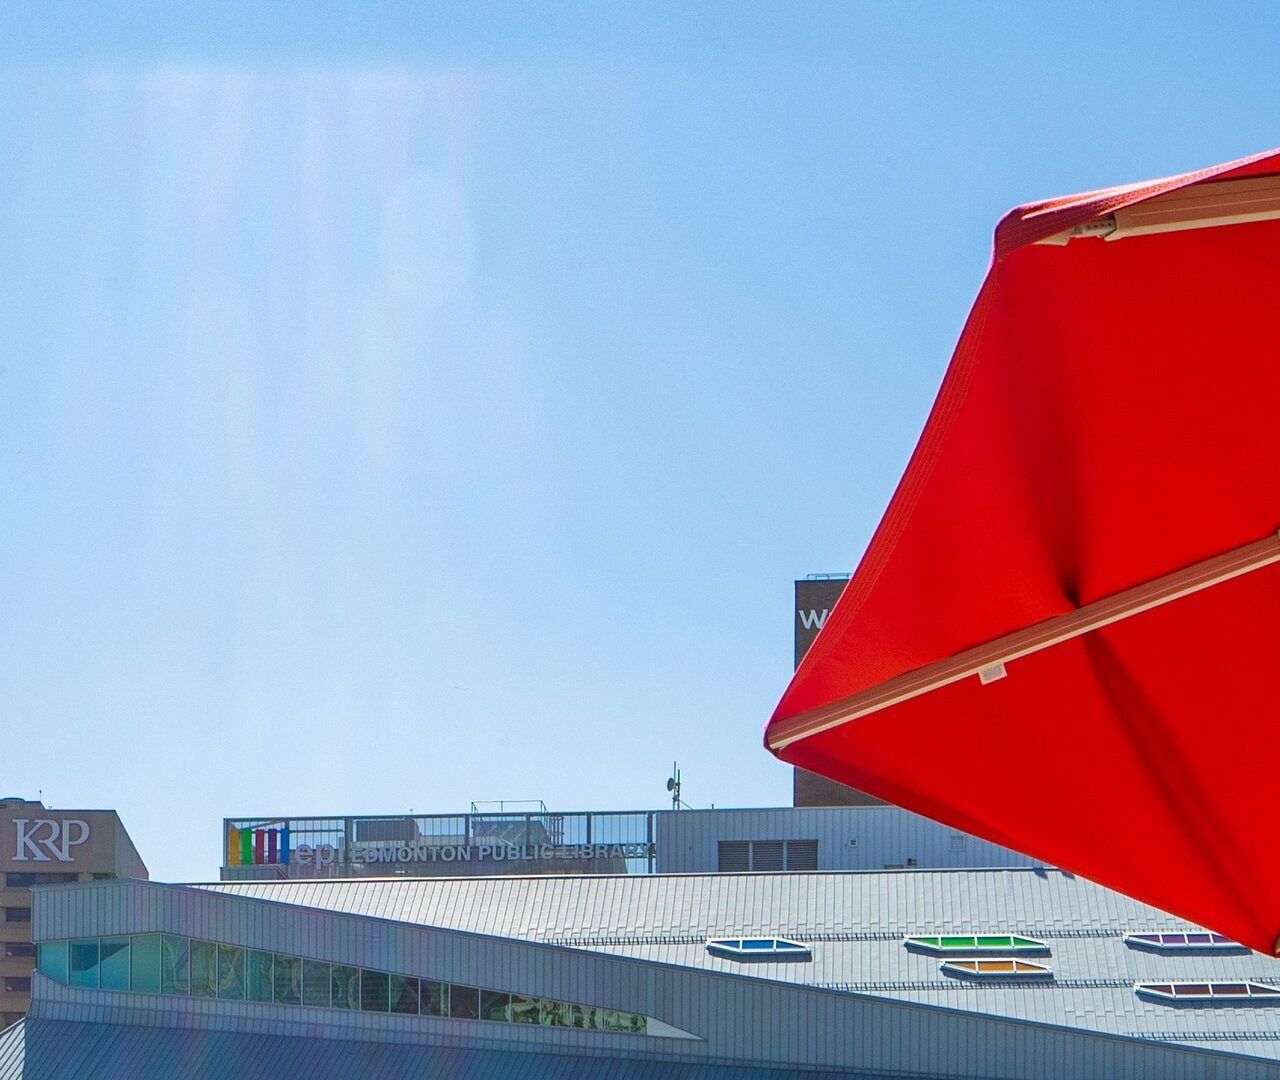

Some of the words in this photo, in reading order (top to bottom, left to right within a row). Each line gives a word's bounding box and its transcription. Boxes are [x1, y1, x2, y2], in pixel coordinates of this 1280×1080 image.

[12, 818, 90, 862] KRP
[350, 845, 471, 863] EDMONTON
[477, 844, 555, 861] PUBLIC
[561, 842, 653, 860] LIBRARY
